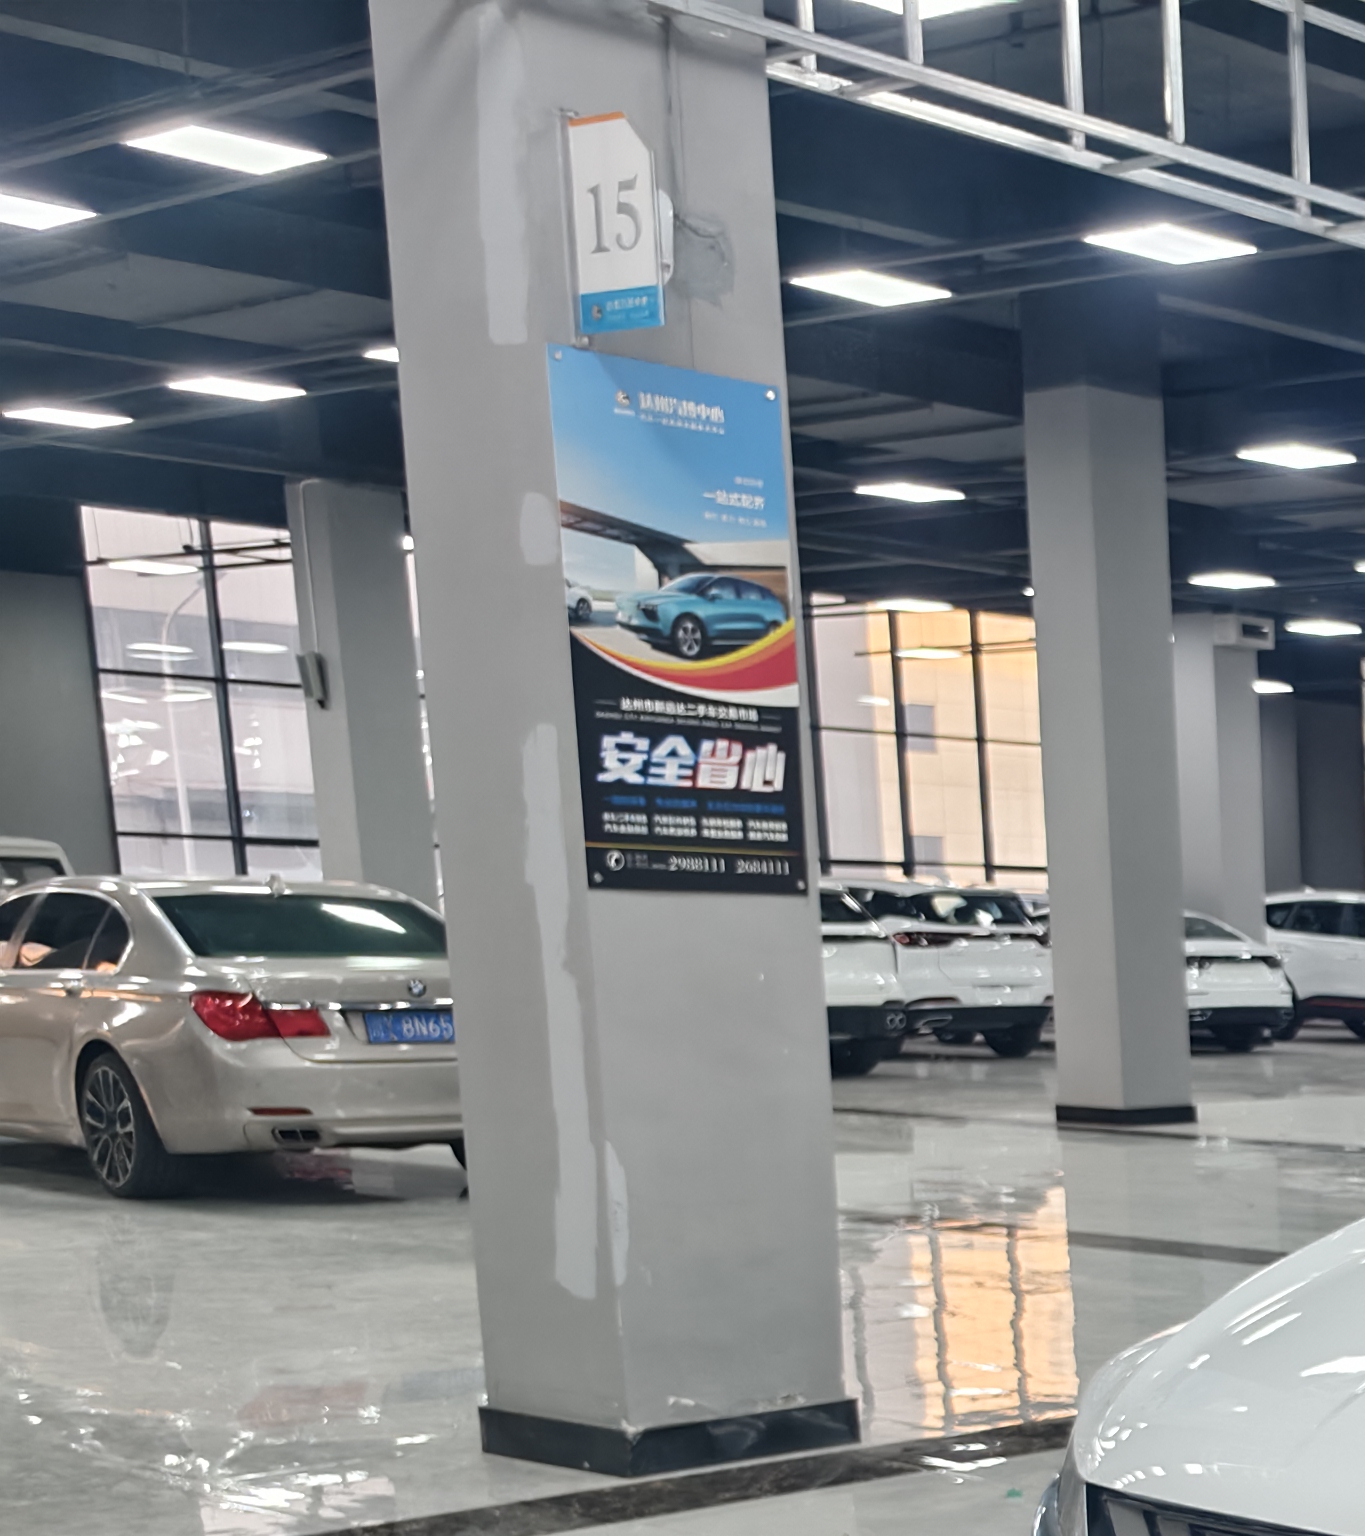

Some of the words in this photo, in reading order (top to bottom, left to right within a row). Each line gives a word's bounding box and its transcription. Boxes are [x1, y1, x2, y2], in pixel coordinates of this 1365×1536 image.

[587, 174, 643, 255] 15
[597, 731, 787, 793] 安全省心
